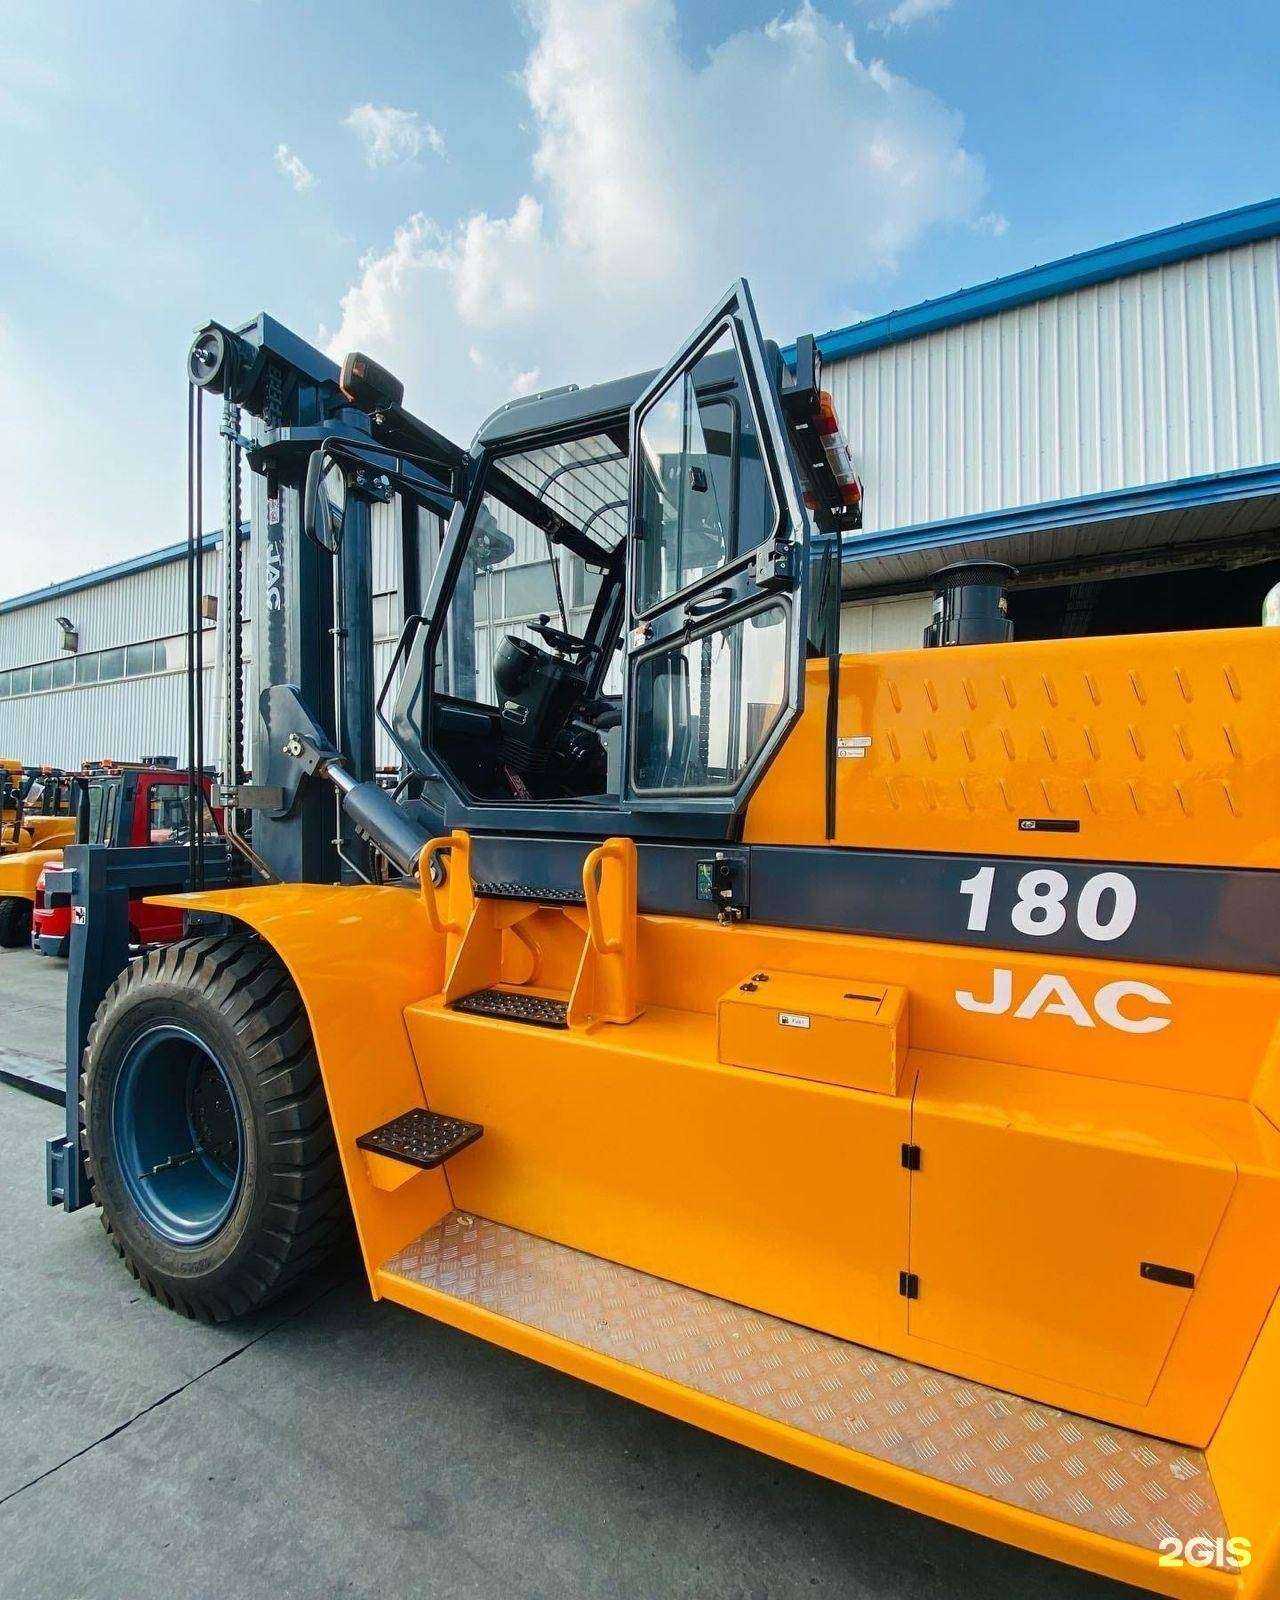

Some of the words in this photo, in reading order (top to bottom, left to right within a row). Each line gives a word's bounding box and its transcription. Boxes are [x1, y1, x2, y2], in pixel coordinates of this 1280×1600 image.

[267, 540, 281, 611] JAC
[959, 866, 1137, 941] 180
[955, 968, 1173, 1034] JAC
